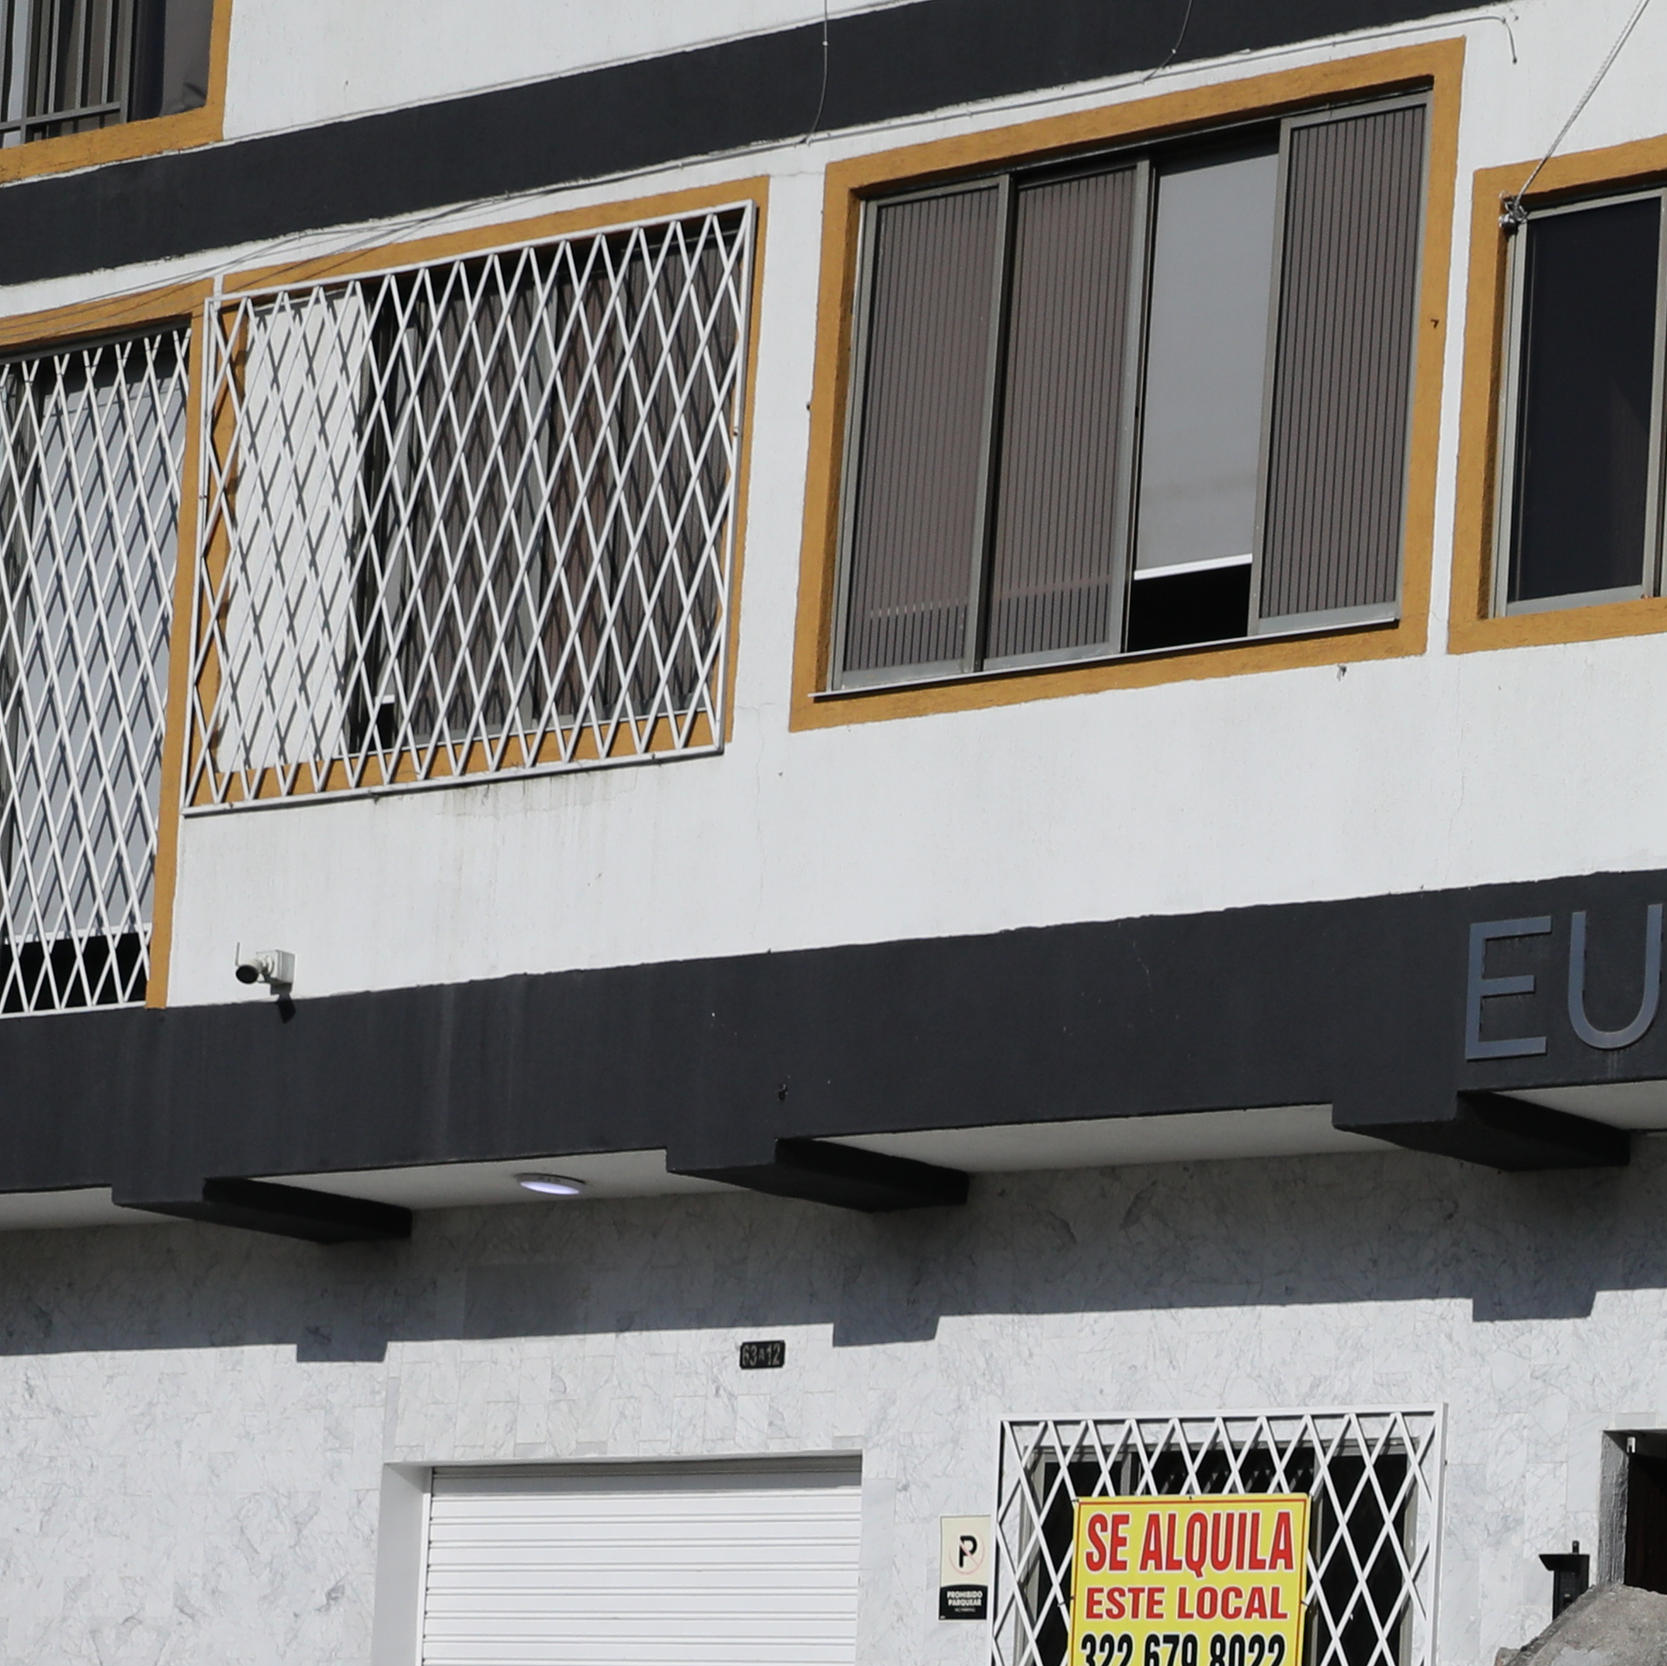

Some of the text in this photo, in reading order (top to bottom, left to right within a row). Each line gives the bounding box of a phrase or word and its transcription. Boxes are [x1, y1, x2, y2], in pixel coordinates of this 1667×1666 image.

[1085, 1511, 1294, 1578] SE ALQUILA
[1085, 1586, 1288, 1619] ESTE LOCAL
